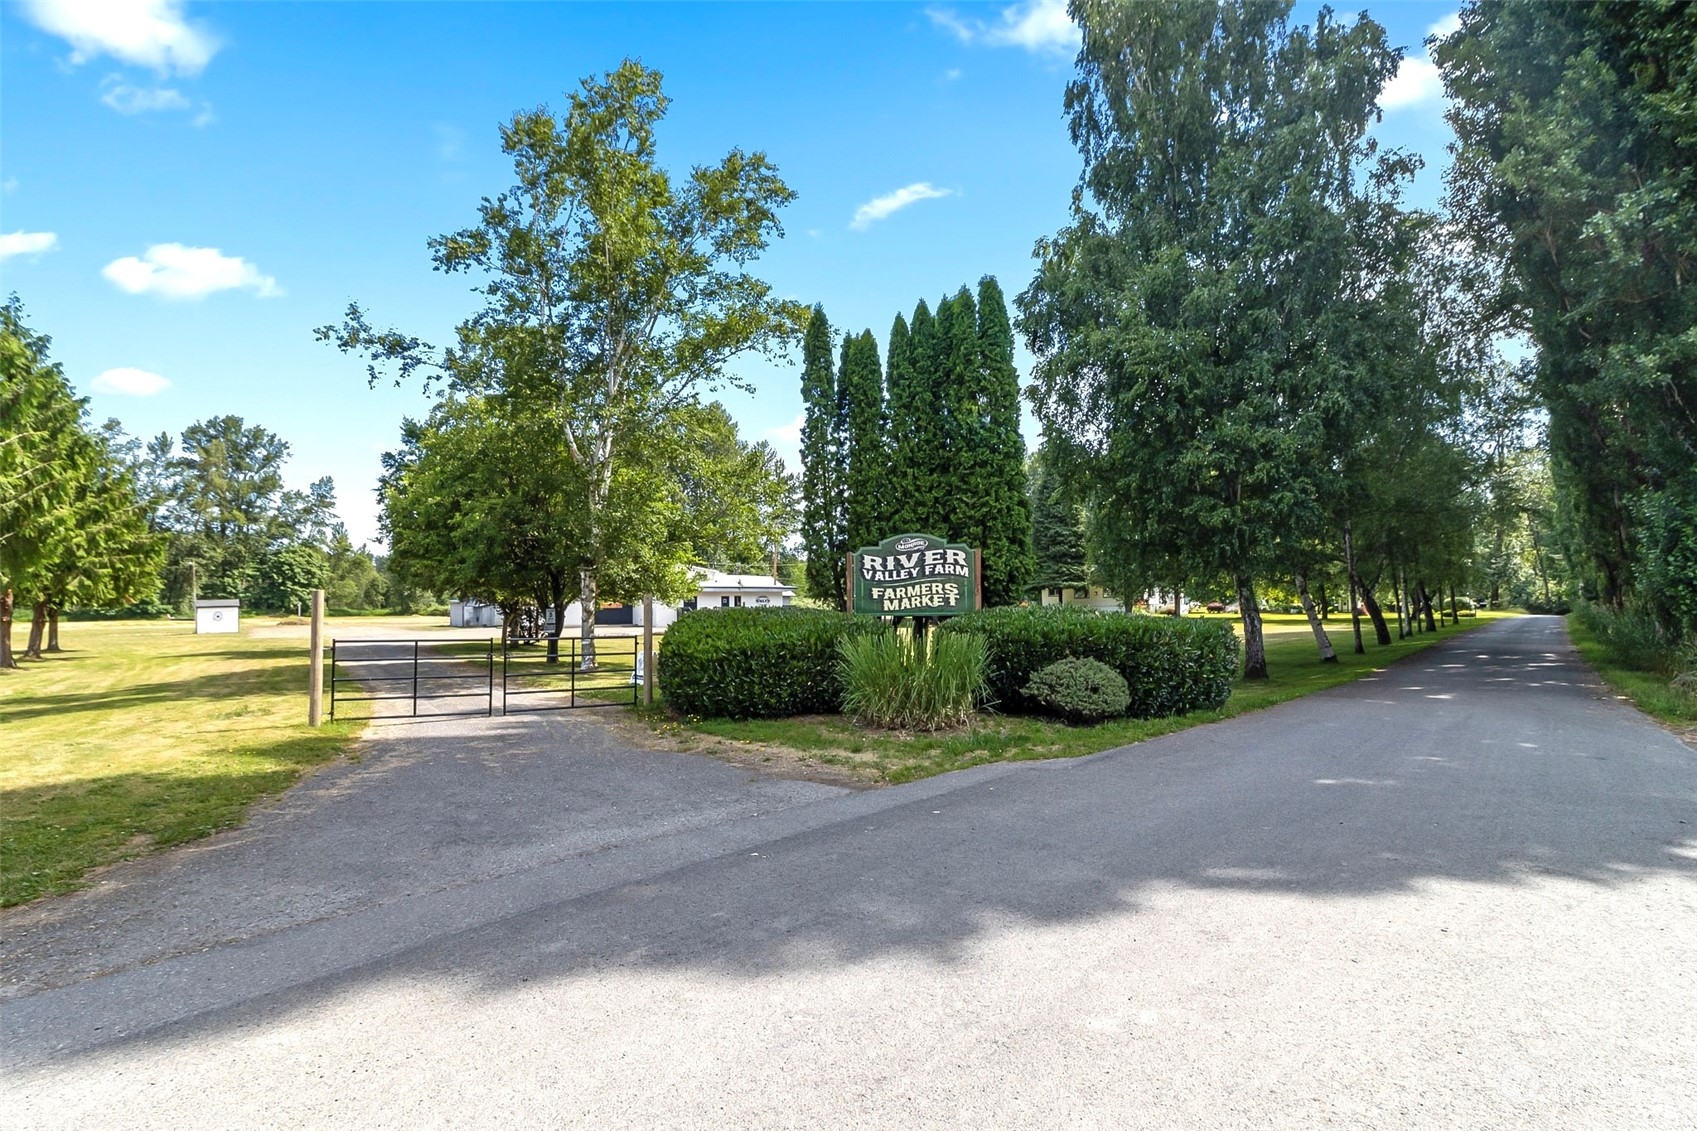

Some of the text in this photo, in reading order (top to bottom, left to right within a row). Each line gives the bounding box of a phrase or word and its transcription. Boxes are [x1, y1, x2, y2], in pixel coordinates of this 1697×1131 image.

[862, 549, 968, 571] RIVER
[862, 564, 970, 581] VALLEY FARM
[883, 594, 960, 611] MARKET
